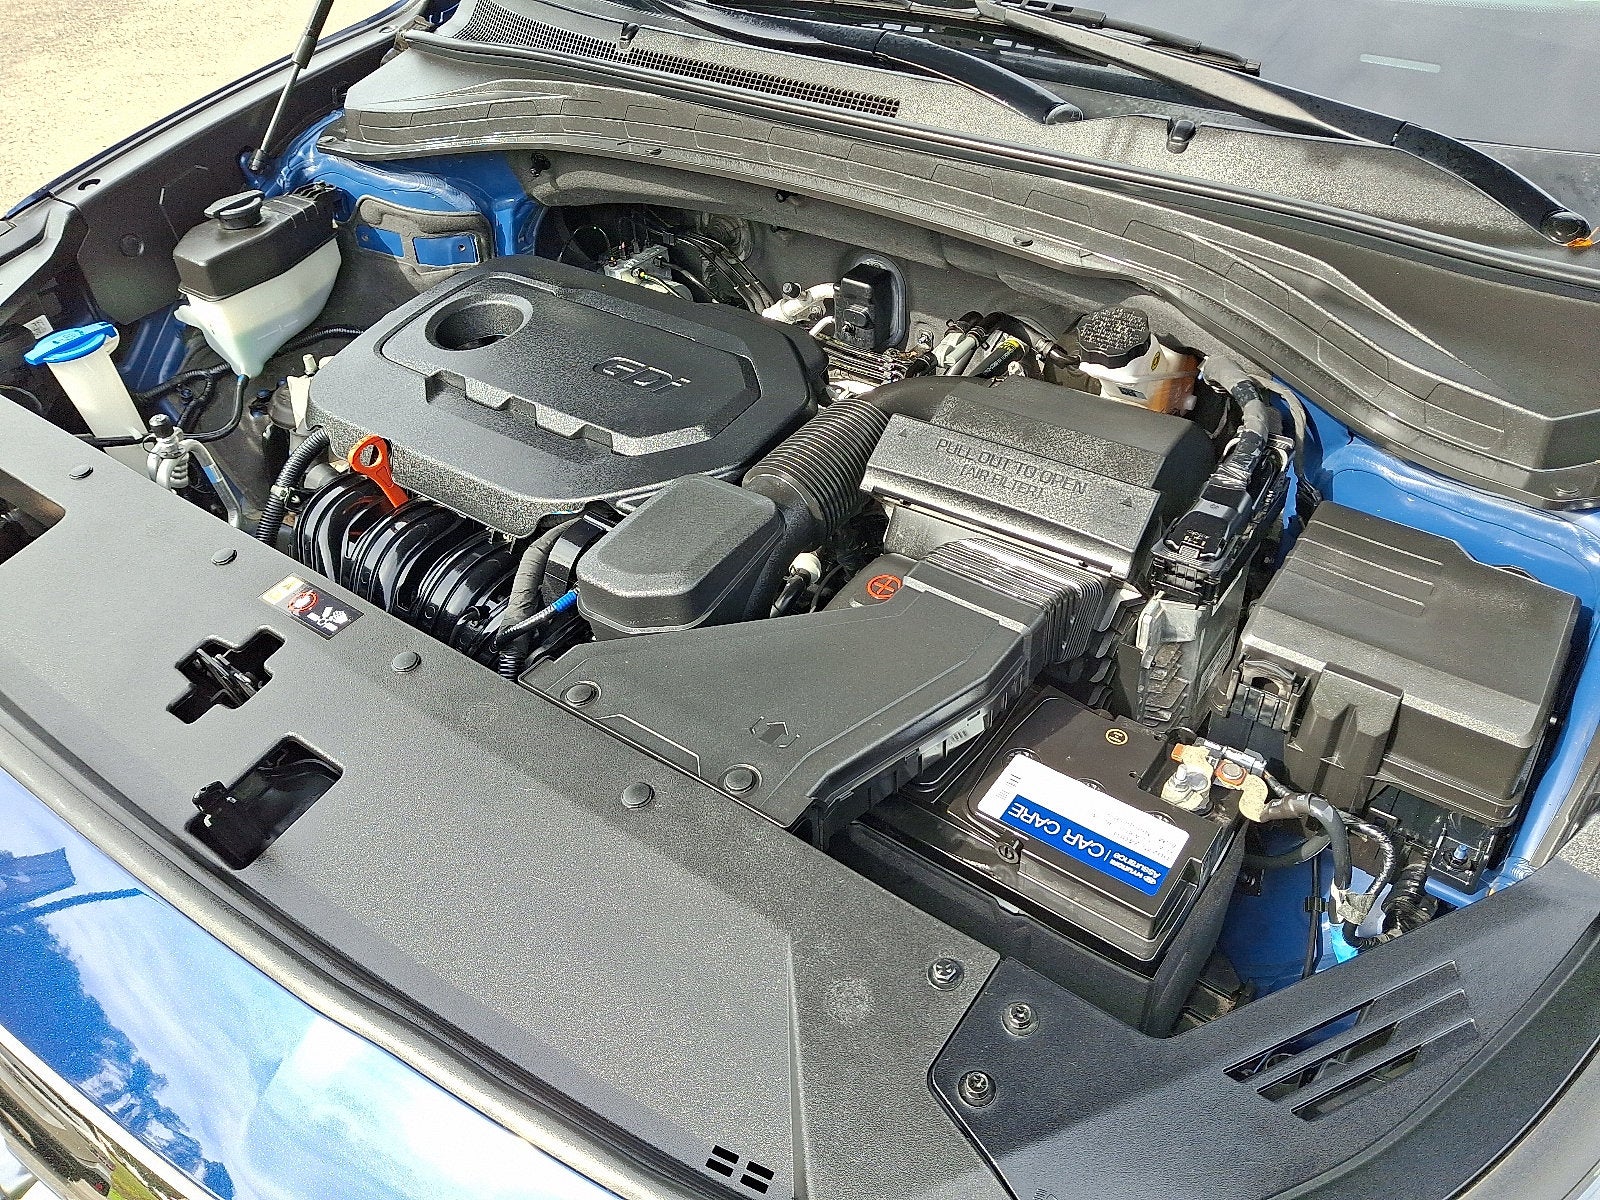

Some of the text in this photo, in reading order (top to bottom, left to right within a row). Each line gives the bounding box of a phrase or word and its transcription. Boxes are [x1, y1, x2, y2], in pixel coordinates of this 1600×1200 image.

[935, 438, 1087, 493] PULL OUT TO OPEN
[1008, 802, 1061, 834] CARE
[1062, 828, 1104, 859] CAR
[1113, 852, 1161, 878] Assurance
